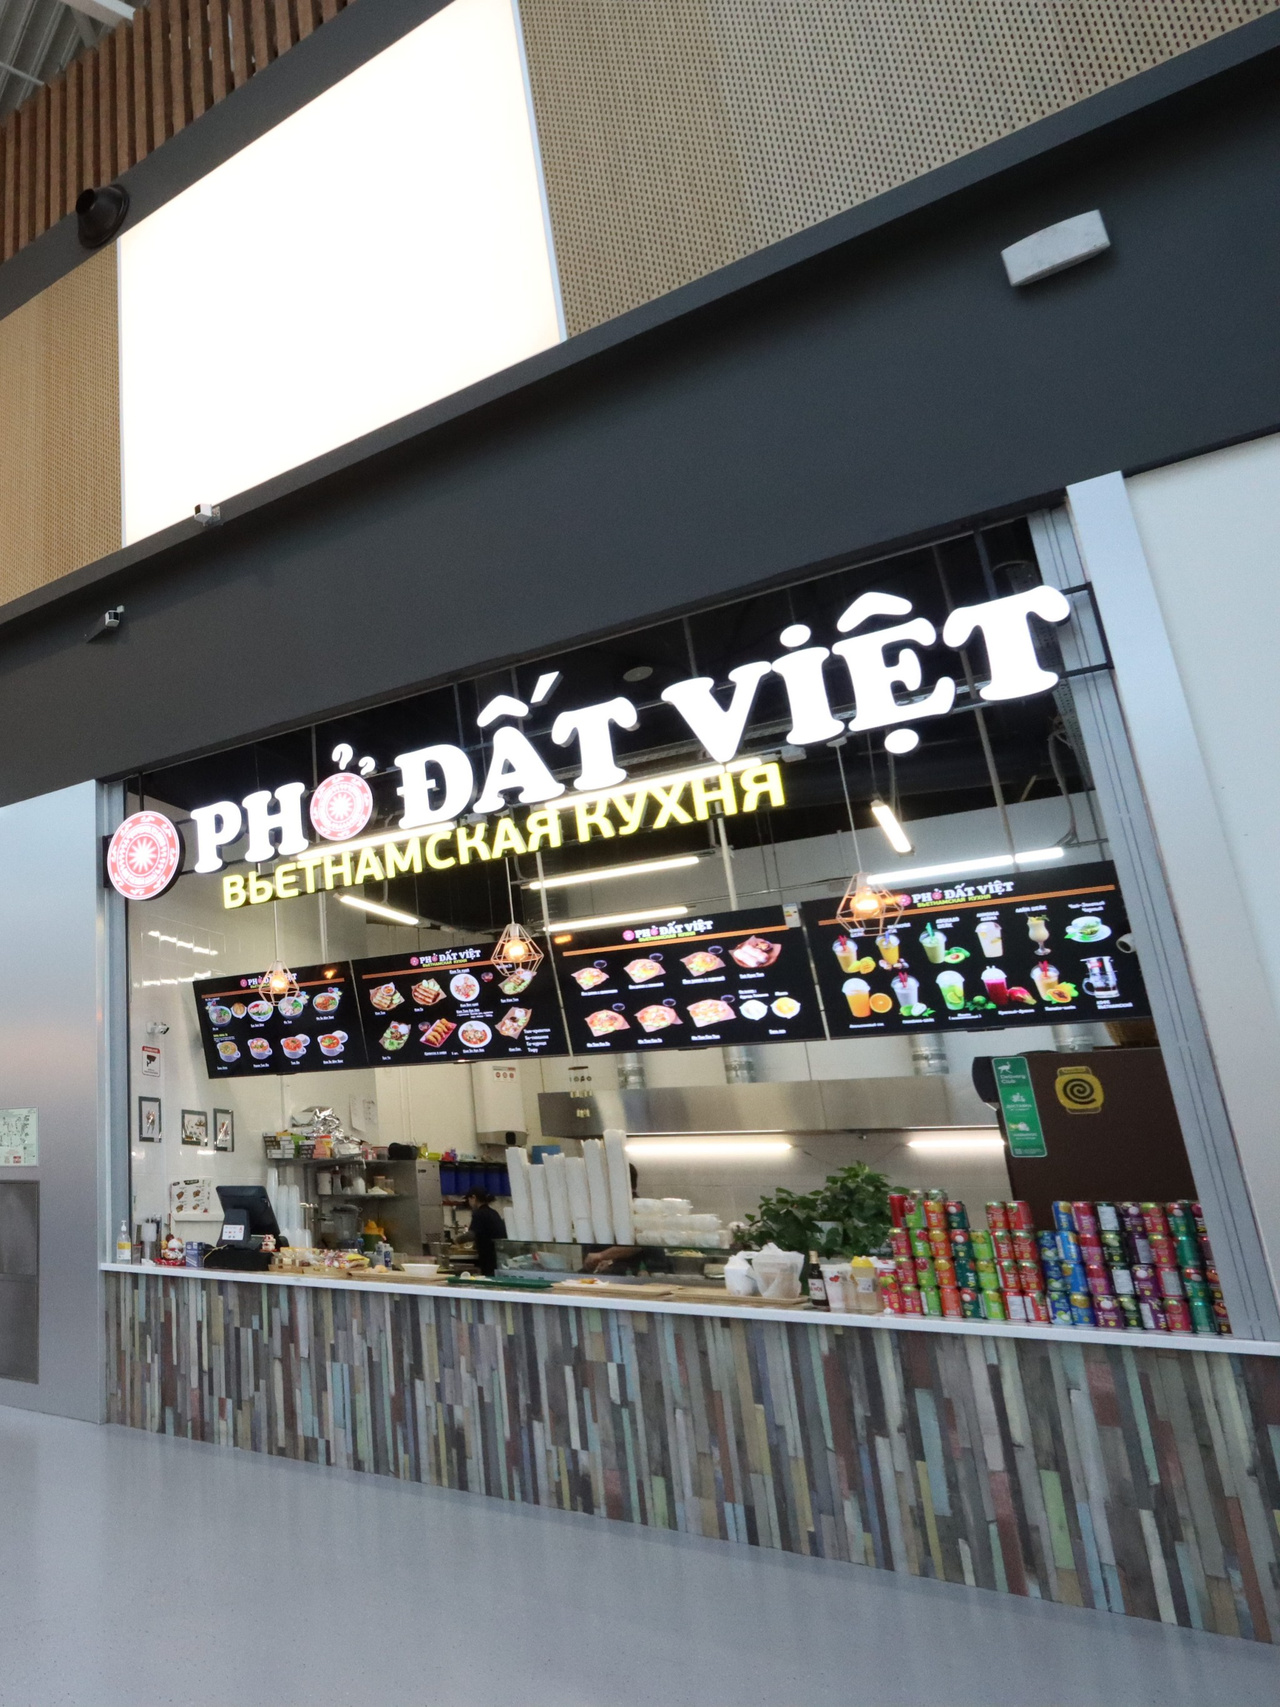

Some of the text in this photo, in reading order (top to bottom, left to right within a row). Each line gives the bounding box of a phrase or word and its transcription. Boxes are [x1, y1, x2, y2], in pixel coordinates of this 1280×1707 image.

[396, 670, 638, 829] ĐẤT
[222, 762, 786, 909] ВЬЕТНАМСКАЯ КУХНЯ
